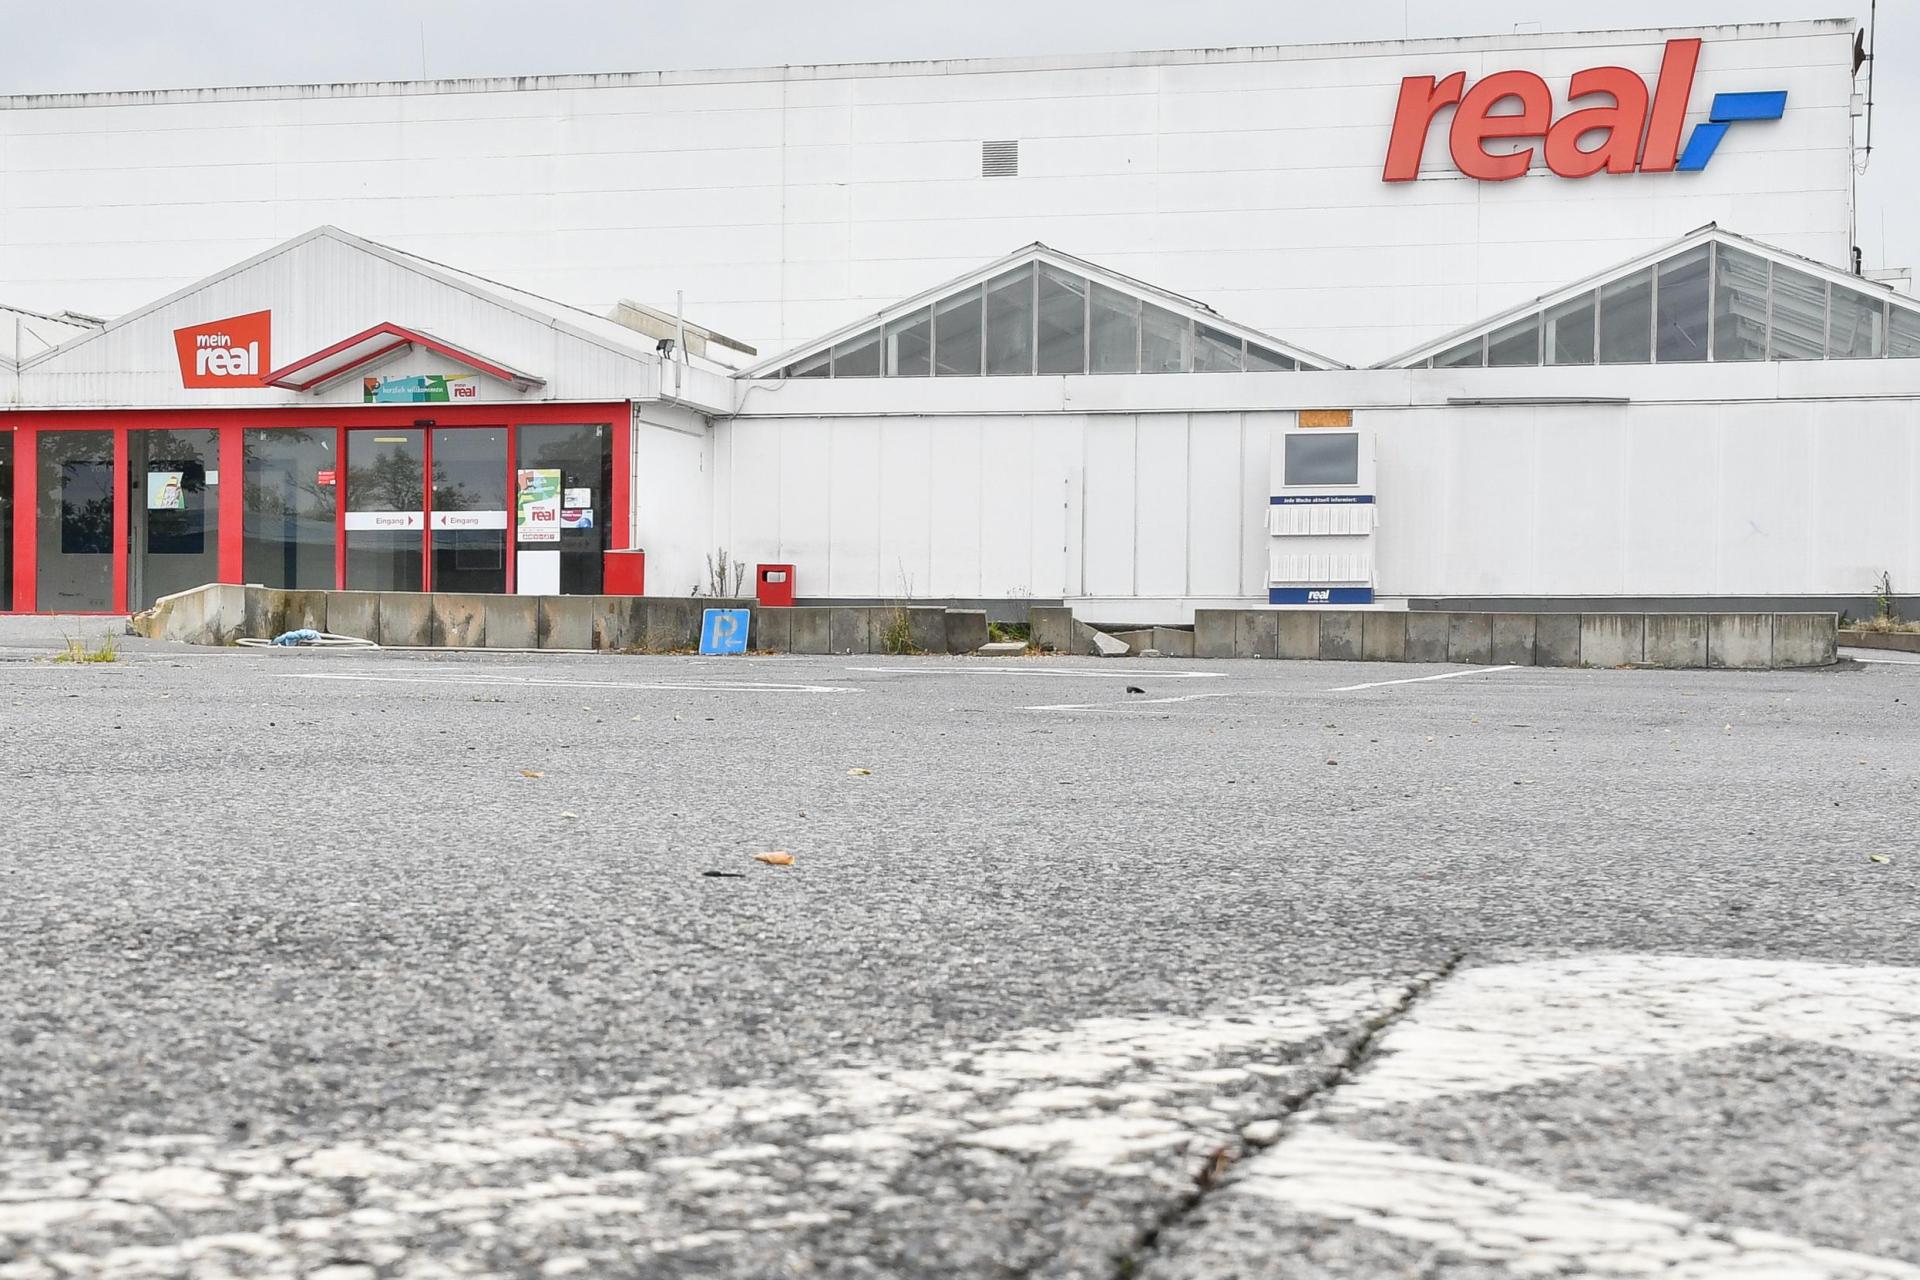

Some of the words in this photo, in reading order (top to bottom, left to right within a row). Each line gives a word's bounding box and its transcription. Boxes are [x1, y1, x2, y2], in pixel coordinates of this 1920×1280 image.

[196, 331, 231, 347] mein
[196, 341, 259, 376] real
[454, 385, 476, 397] real
[450, 516, 479, 525] Eingang
[531, 508, 556, 521] real
[375, 517, 405, 526] Eingang
[1308, 588, 1330, 600] real
[712, 615, 738, 649] P
